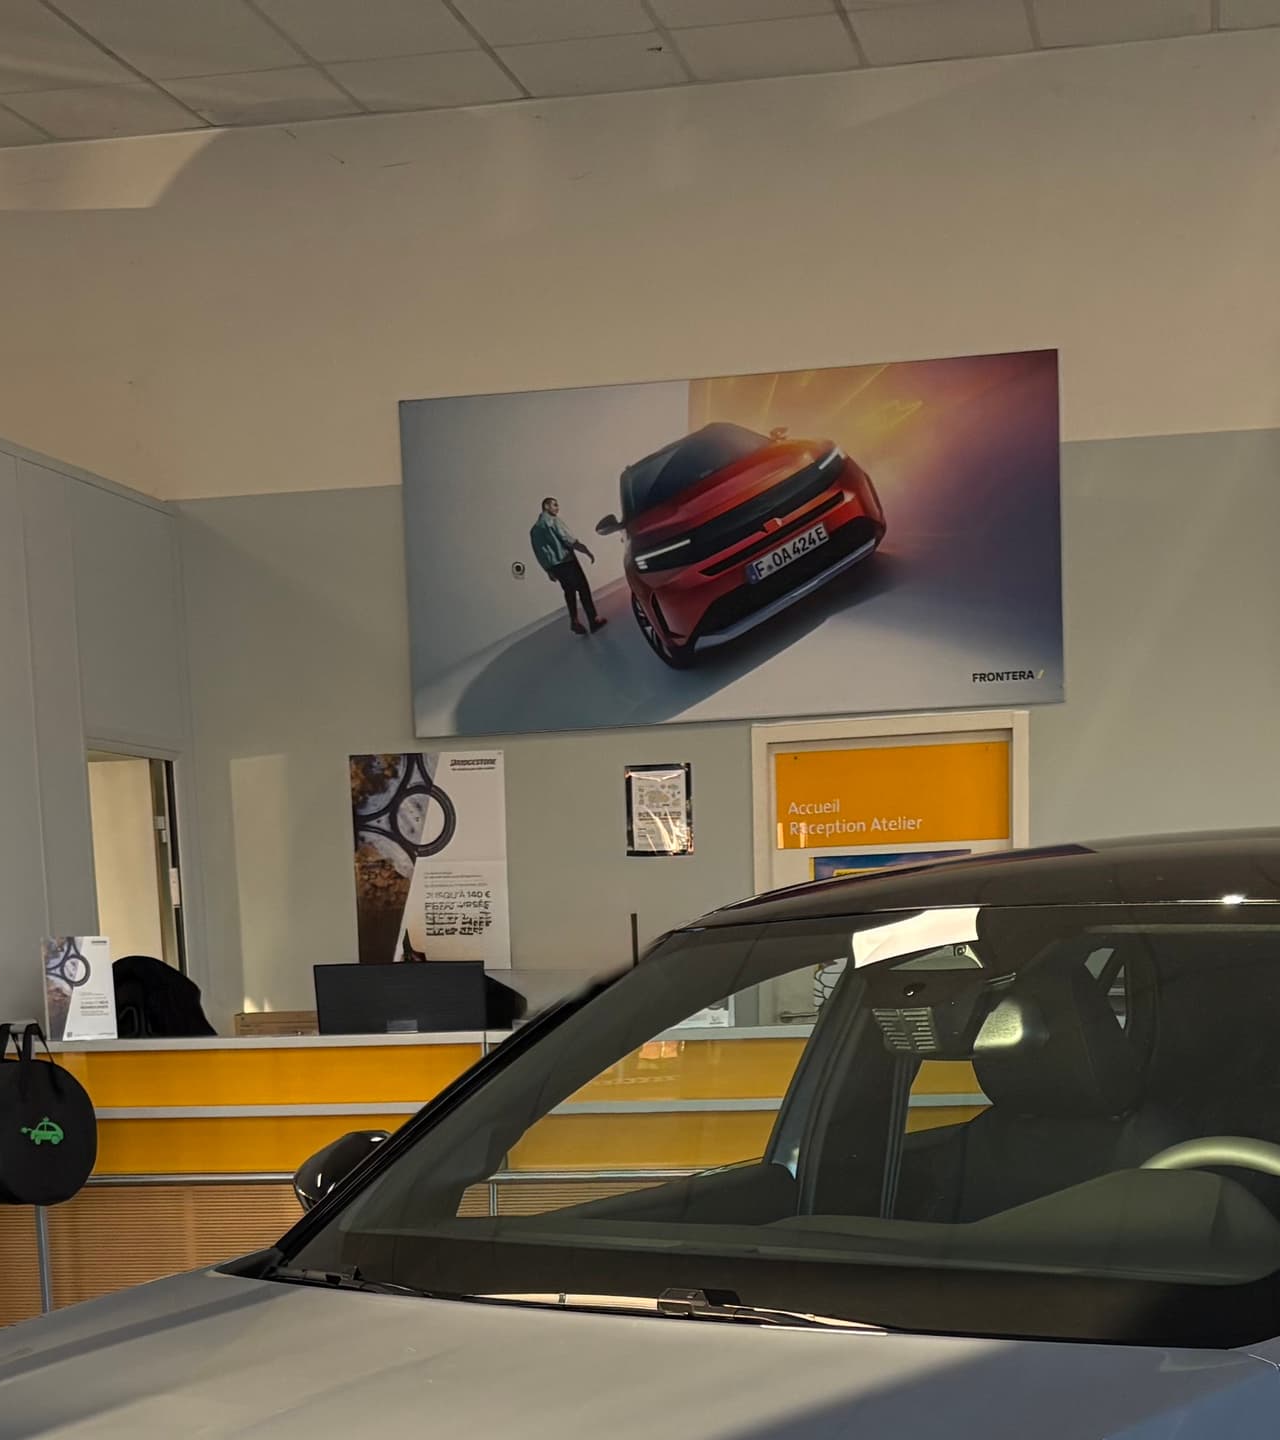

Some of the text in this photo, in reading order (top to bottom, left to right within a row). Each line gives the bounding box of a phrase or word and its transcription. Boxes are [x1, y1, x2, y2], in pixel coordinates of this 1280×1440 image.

[972, 670, 1034, 683] FRONTERA
[788, 799, 840, 815] Accueil
[871, 816, 923, 832] Atelier
